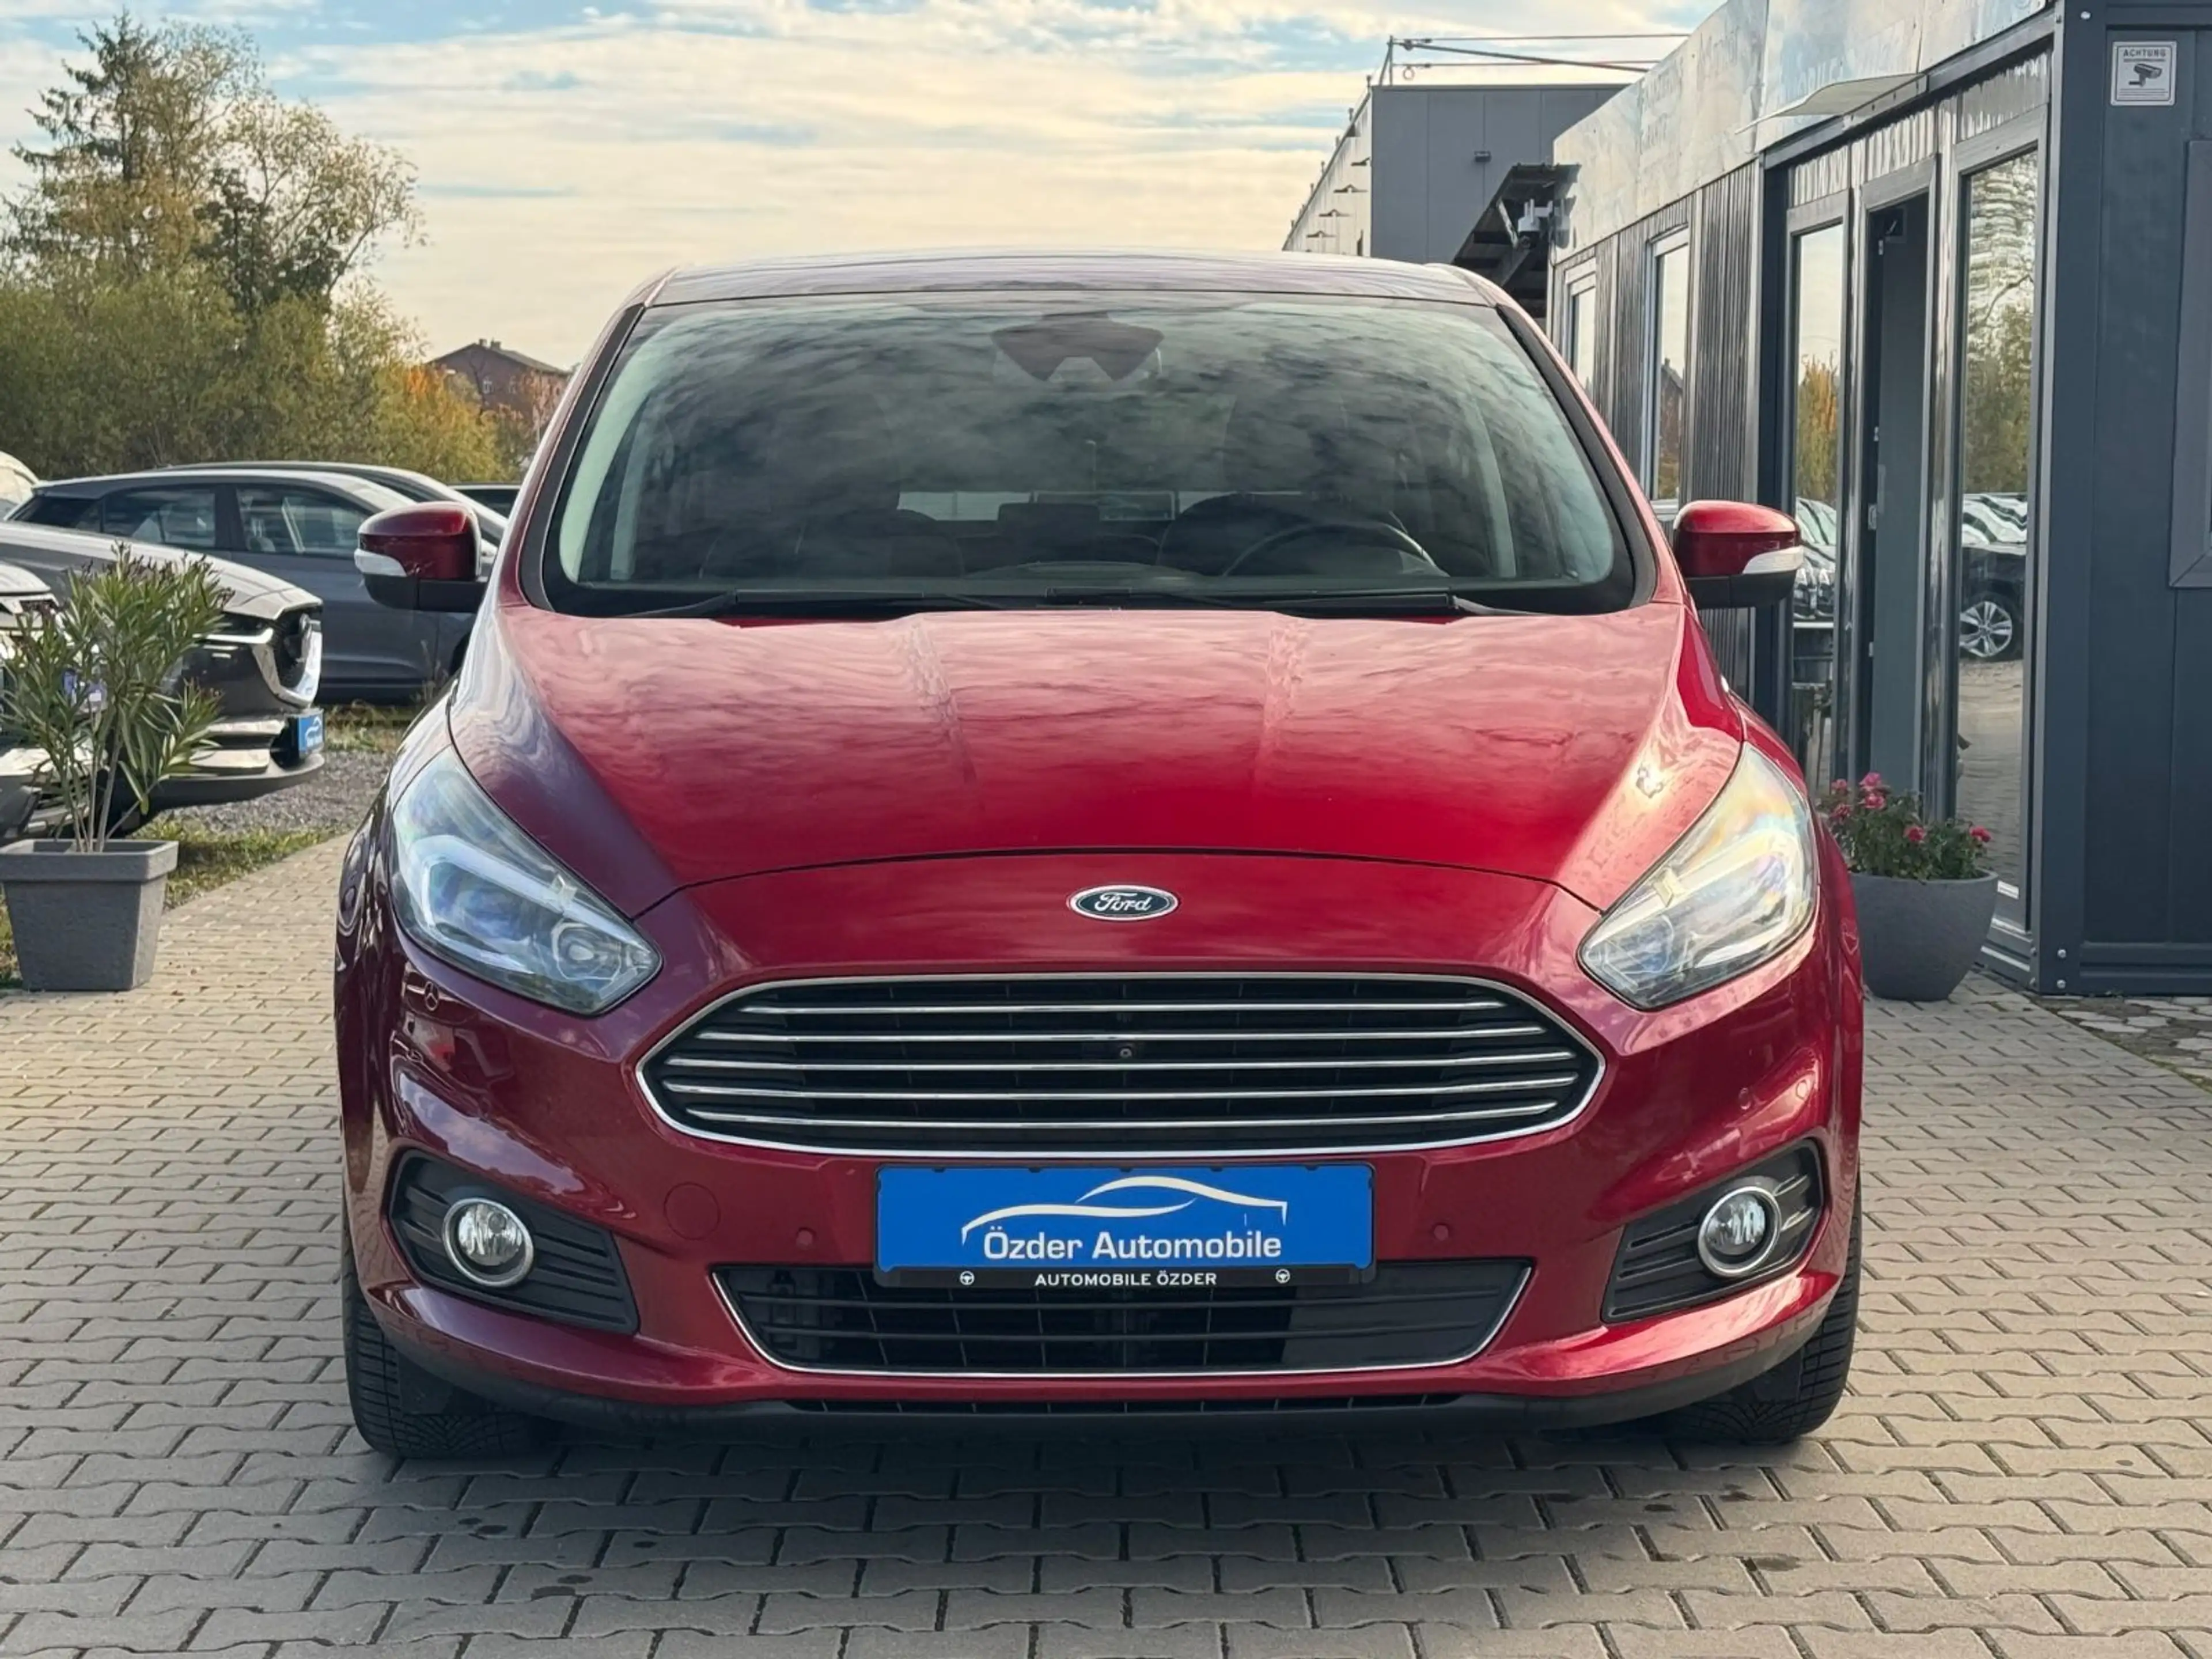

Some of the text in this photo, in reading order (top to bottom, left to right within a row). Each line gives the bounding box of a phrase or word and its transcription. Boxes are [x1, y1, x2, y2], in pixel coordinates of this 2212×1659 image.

[2123, 48, 2166, 57] ACHTUNG
[1094, 892, 1153, 911] Ford
[983, 1226, 1281, 1259] Özder Automobile
[1035, 1270, 1217, 1286] AUTOMOBILE ÖZDER
